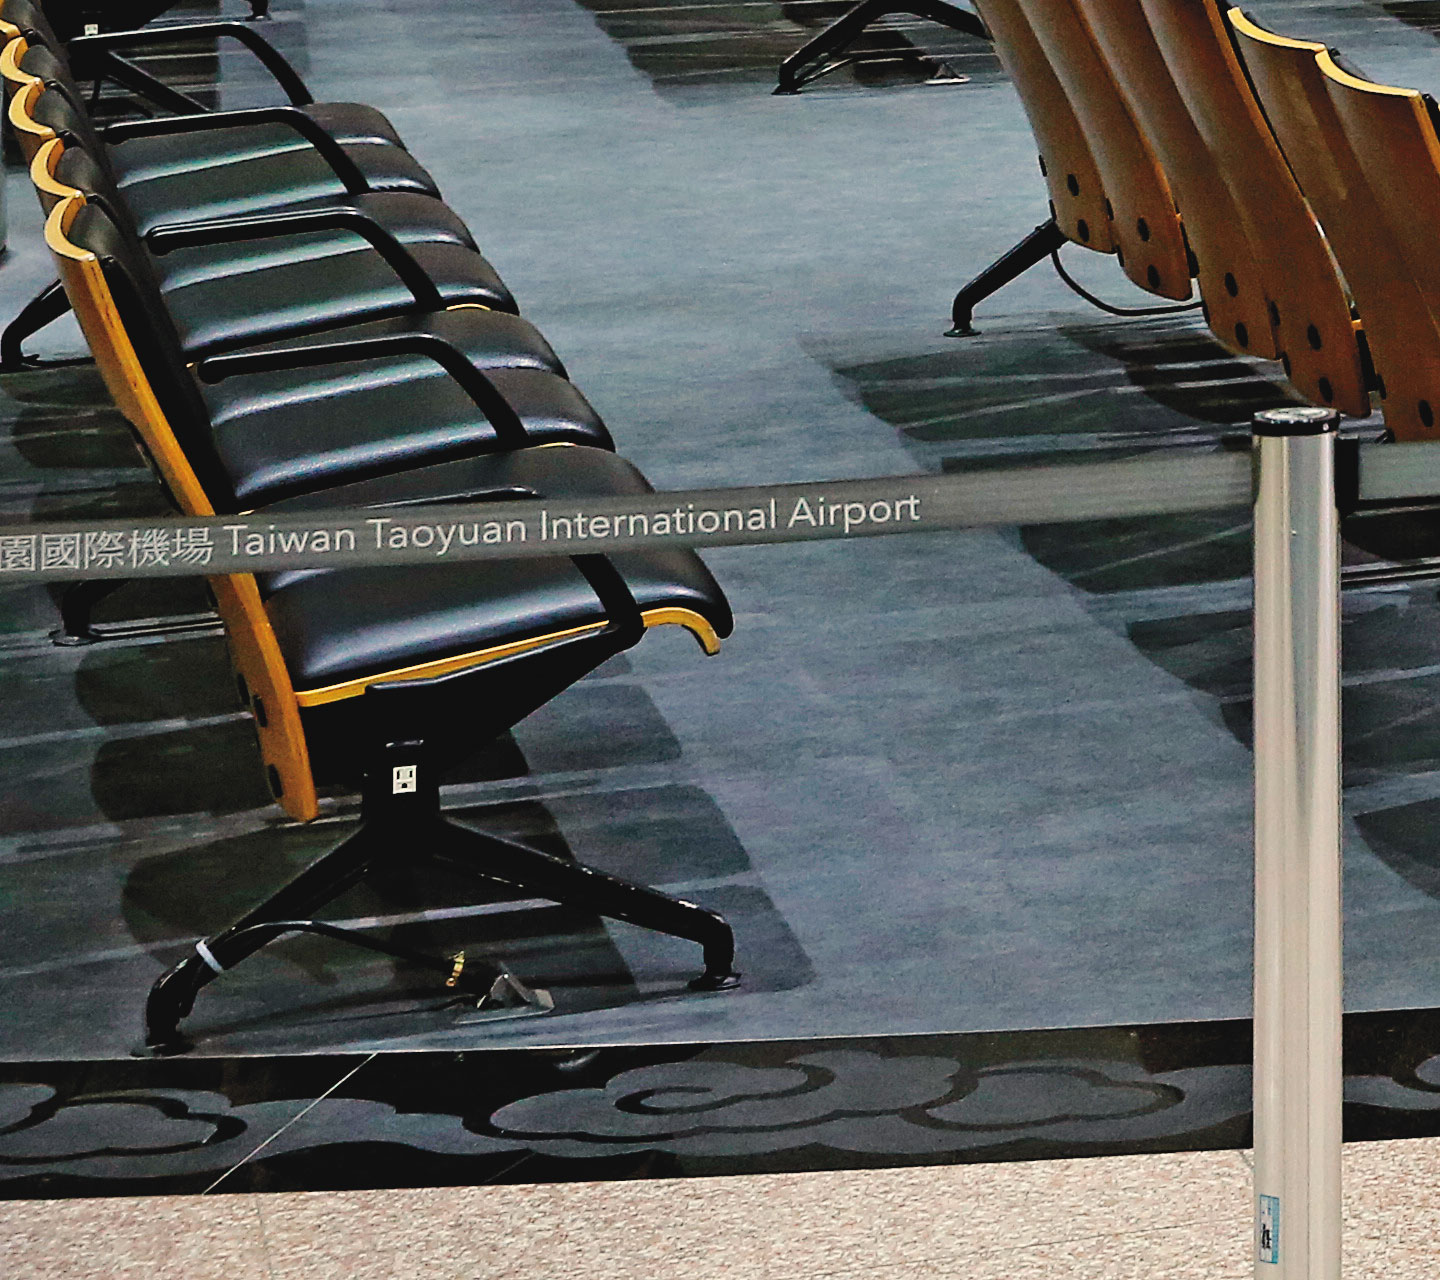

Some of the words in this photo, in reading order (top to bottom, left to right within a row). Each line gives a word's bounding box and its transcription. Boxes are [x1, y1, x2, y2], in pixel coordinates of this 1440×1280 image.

[223, 523, 355, 556] Taiwan
[365, 517, 527, 557] Taoyuan
[540, 498, 776, 540] International
[787, 494, 921, 534] Airport
